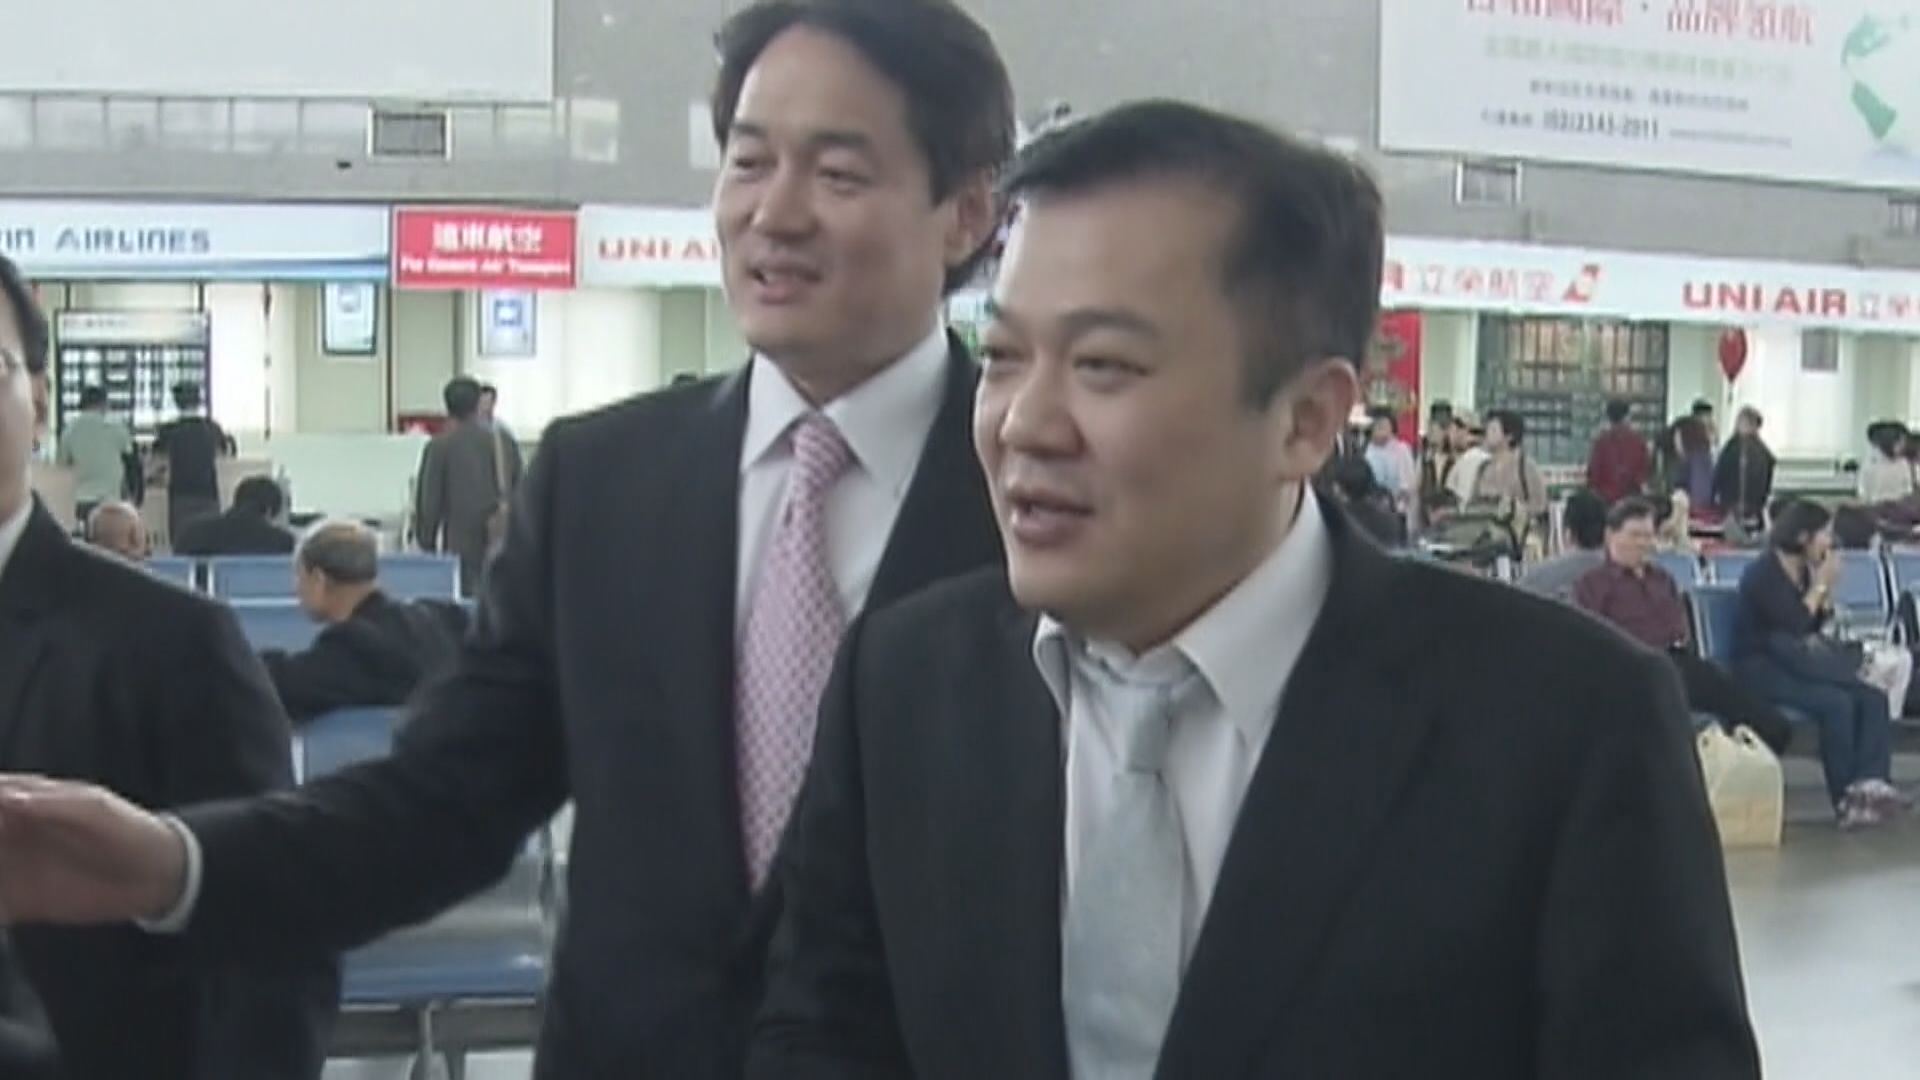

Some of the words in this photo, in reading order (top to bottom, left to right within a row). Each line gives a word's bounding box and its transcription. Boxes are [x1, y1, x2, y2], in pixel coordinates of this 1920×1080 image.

[0, 228, 35, 250] IN
[56, 226, 211, 252] AIRLINES
[600, 237, 669, 260] UNI
[682, 239, 719, 260] AI
[1683, 282, 1763, 311] UNI
[1773, 286, 1848, 317] AIR
[1857, 291, 1920, 320] 立榮
